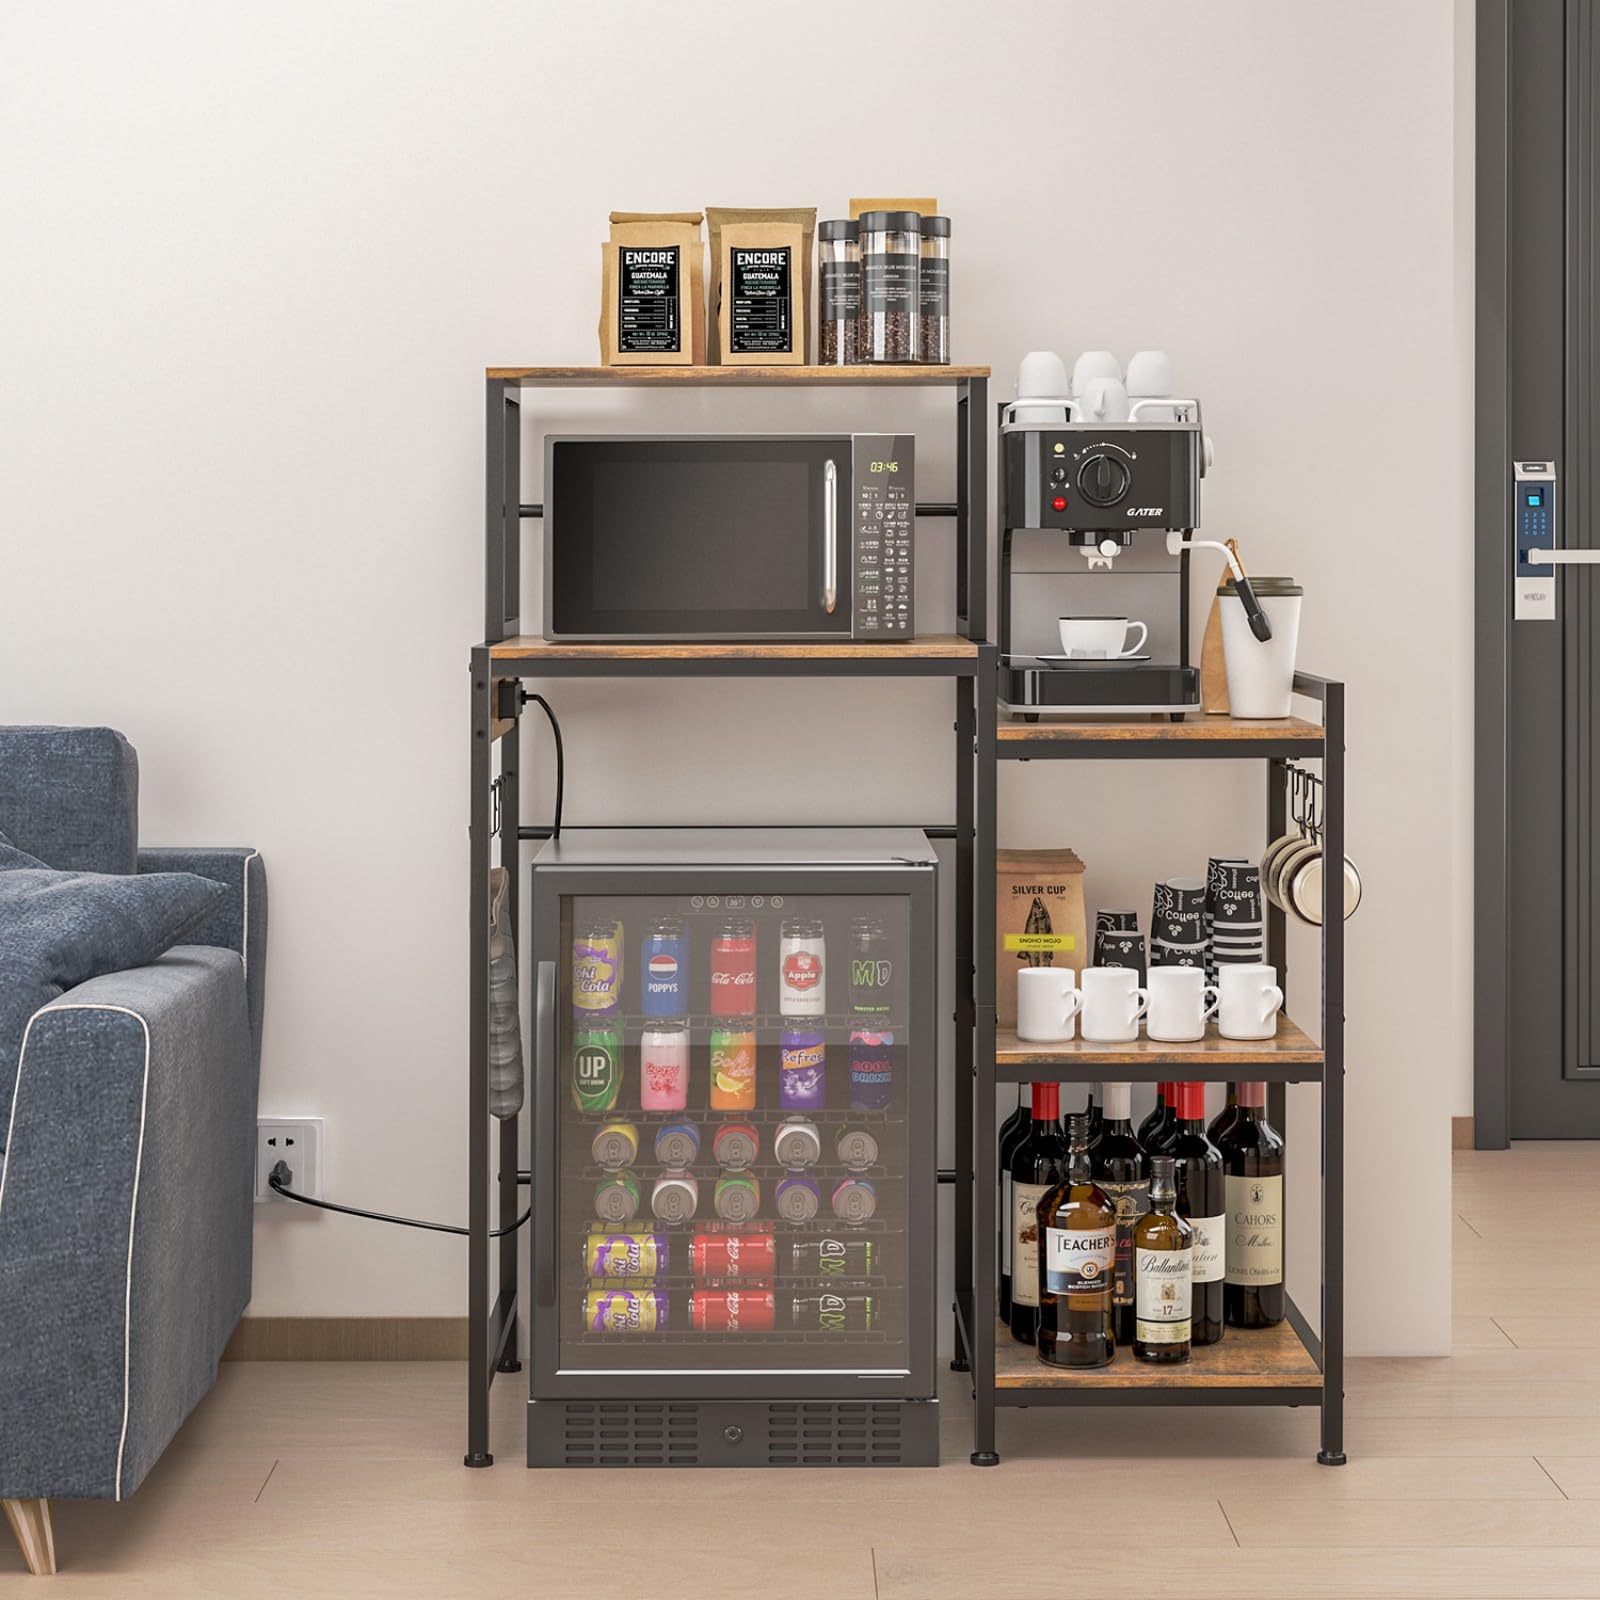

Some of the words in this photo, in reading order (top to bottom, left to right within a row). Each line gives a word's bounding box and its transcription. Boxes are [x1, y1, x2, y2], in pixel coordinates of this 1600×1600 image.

[625, 251, 675, 265] ENCORE
[737, 252, 786, 266] ENCORE
[870, 461, 899, 473] 03:46
[1126, 508, 1163, 516] GATER
[1012, 885, 1044, 895] SILVER
[1046, 885, 1067, 895] CUP
[788, 971, 817, 981] Apple
[581, 979, 612, 993] Cola
[648, 983, 678, 993] POPPYS
[579, 1056, 606, 1078] UP
[1234, 1214, 1277, 1225] CAHORS
[1055, 1233, 1115, 1254] TEACHER'S
[626, 1242, 641, 1274] Cola
[626, 1297, 641, 1329] Cola
[1163, 1305, 1173, 1315] 17
